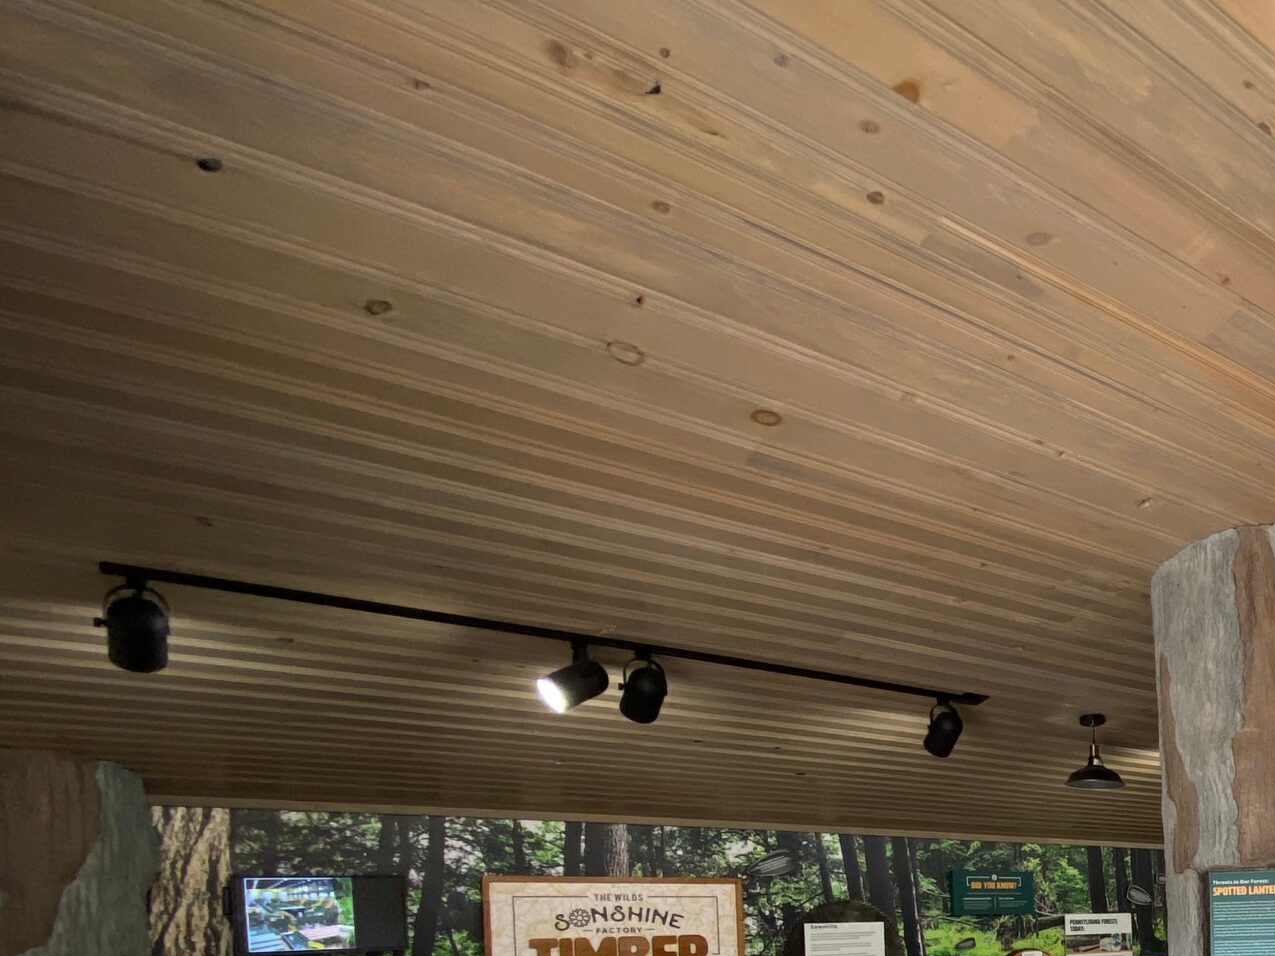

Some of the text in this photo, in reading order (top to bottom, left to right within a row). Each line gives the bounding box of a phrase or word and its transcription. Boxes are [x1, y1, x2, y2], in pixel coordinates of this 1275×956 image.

[1212, 885, 1247, 896] SPOTTED
[594, 893, 644, 902] THE WILDS
[596, 926, 642, 934] FACTORY
